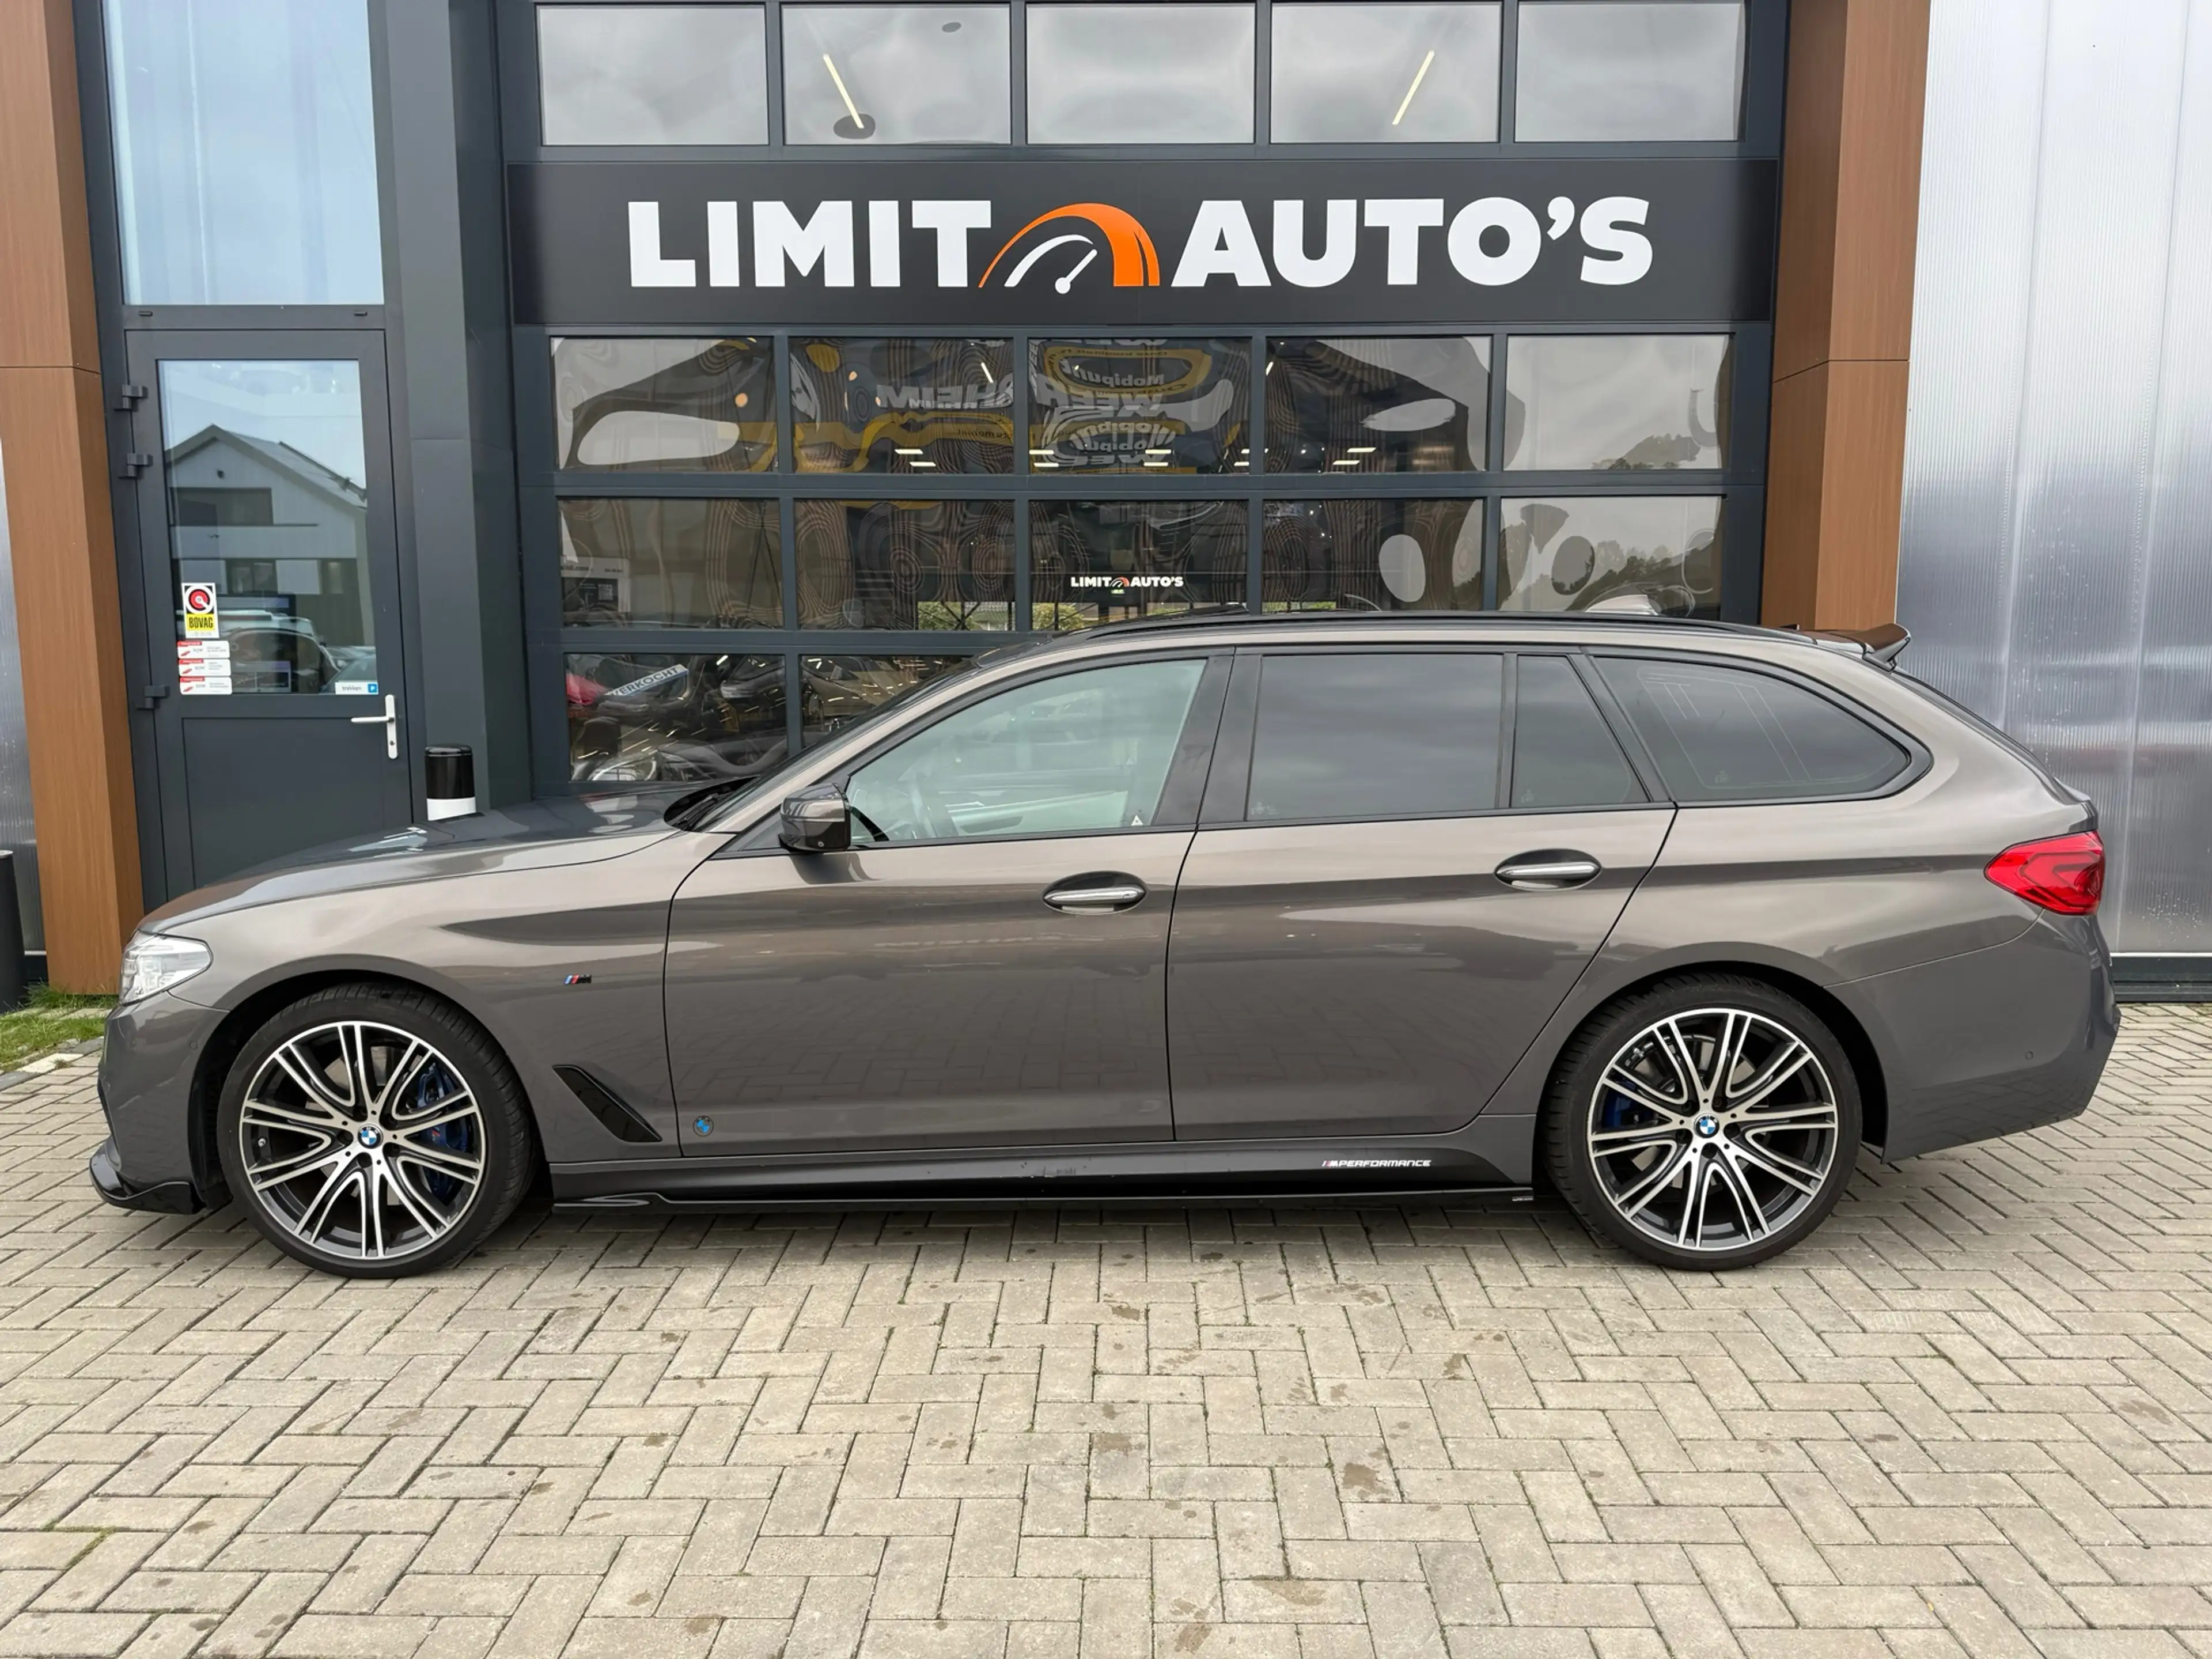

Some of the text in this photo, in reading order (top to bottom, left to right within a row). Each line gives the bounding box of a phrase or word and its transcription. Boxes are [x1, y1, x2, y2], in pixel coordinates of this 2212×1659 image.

[628, 196, 1653, 287] LIMIT AUTO'S
[1070, 577, 1184, 588] LIMIT AUTO'S
[188, 617, 214, 629] BOVAG
